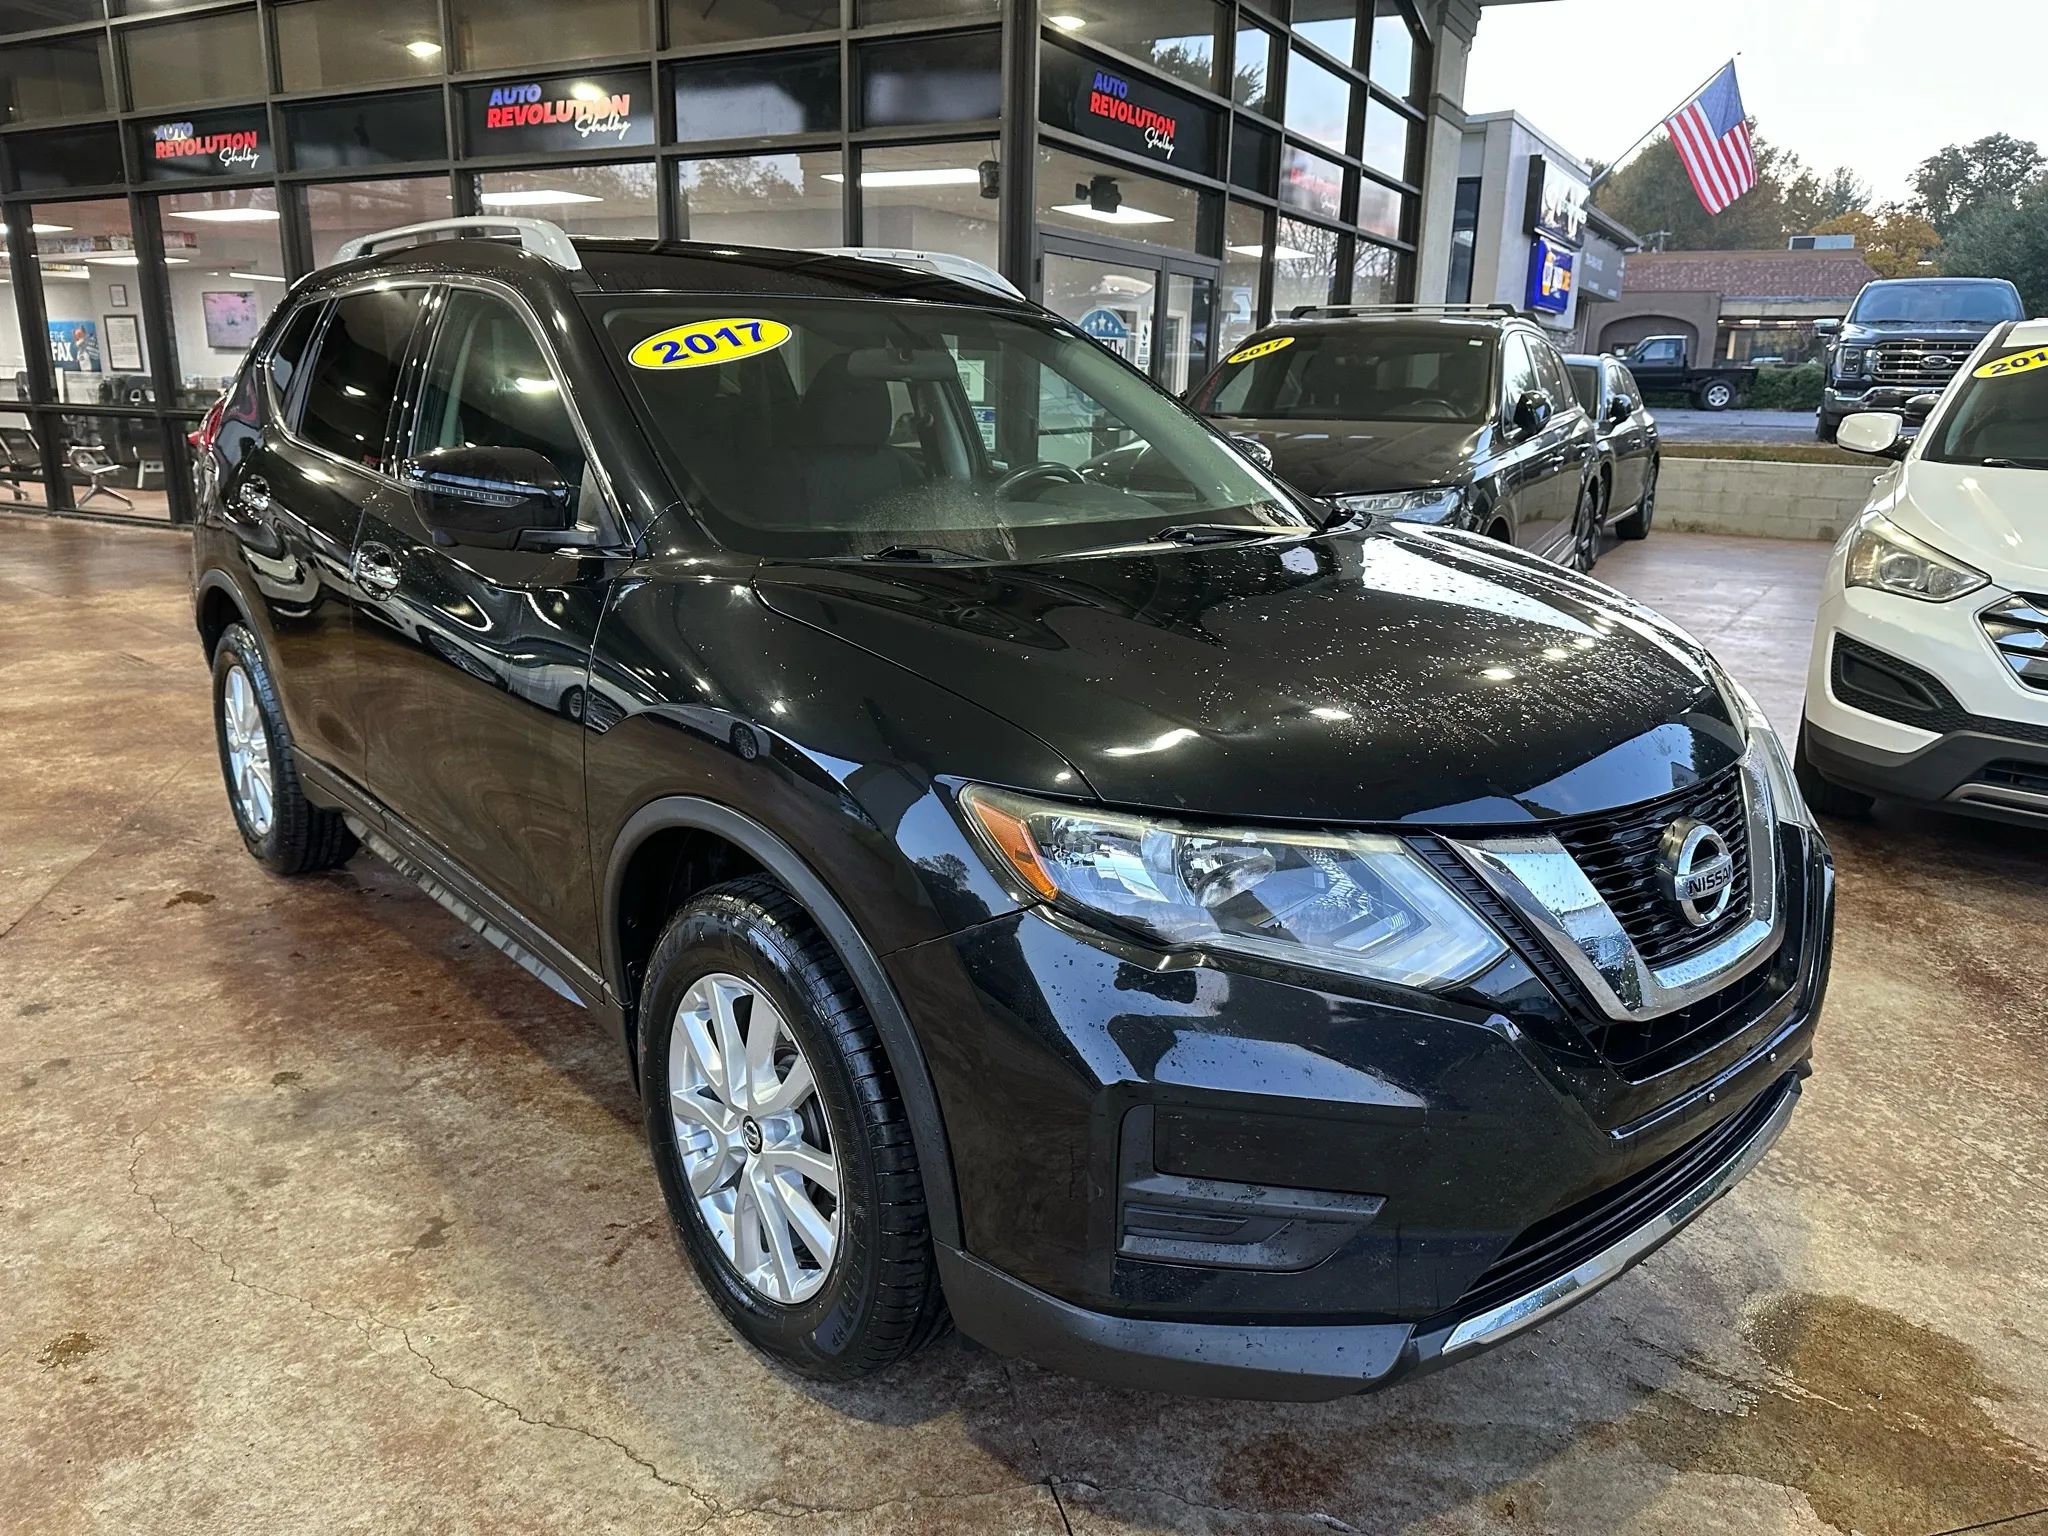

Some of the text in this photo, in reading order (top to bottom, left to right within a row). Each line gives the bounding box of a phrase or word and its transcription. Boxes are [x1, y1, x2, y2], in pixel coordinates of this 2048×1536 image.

[488, 83, 542, 106] AUTO
[1092, 72, 1128, 99] AUTO
[487, 94, 631, 129] REVOLUTION
[1090, 91, 1176, 139] REVOLUTION
[154, 122, 194, 140] AUTO
[574, 115, 631, 140] Shelby
[155, 131, 257, 159] REVOLUTION
[219, 144, 260, 169] Shelby
[1144, 126, 1175, 160] Shelby
[652, 321, 763, 364] 2017
[1236, 339, 1285, 361] 2017
